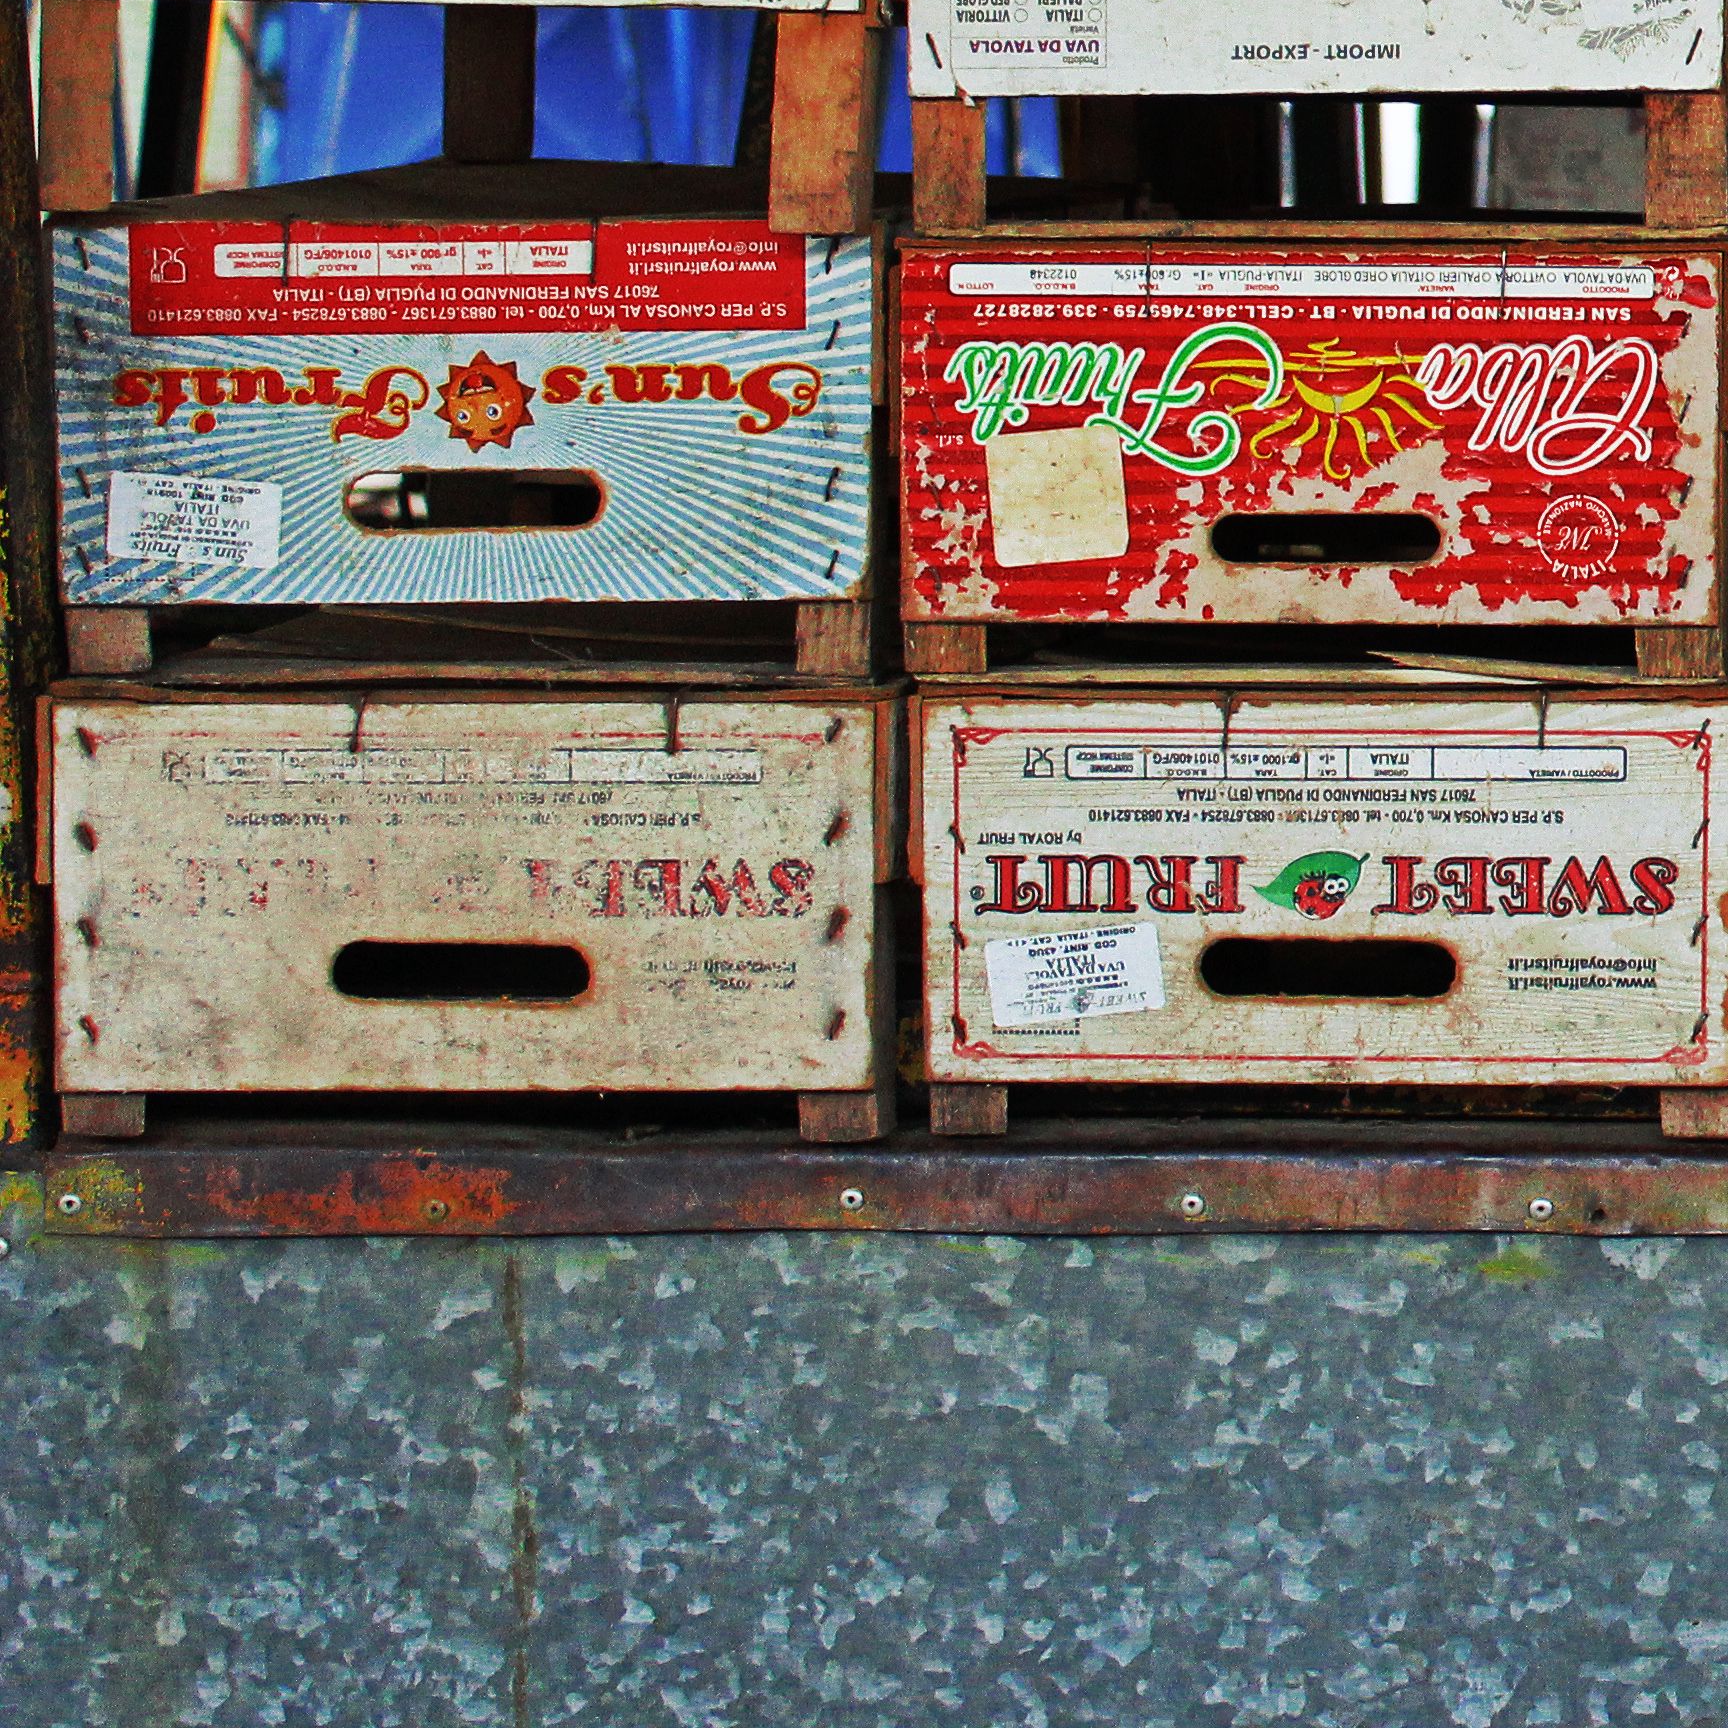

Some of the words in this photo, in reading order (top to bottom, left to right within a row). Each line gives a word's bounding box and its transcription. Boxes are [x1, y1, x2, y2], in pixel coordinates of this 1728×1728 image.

[969, 40, 1034, 52] TAVOLA
[1038, 40, 1060, 52] DA
[1065, 40, 1099, 52] UVA
[1231, 44, 1308, 60] EXPORT
[1324, 44, 1400, 60] IMPORT
[626, 240, 777, 255] info@royalfruitsrl.it
[628, 260, 776, 275] www.royalfruitsrl.it
[147, 309, 241, 321] 0883.621410
[246, 308, 277, 321] FAX
[293, 308, 387, 321] 0883.678254
[973, 303, 1097, 317] 339.2828727
[1310, 305, 1334, 318] BT
[1352, 305, 1425, 319] PUGLIA
[1431, 306, 1451, 320] DI
[1457, 306, 1585, 320] FERDINANDO
[1592, 307, 1631, 321] SAN
[110, 361, 429, 444] Fruits
[540, 359, 824, 435] Sun's
[943, 324, 1281, 476] Fruits
[1177, 788, 1216, 800] ITALIA
[1255, 788, 1304, 801] PUGLIA
[1323, 788, 1407, 801] FERDINANDO
[1411, 788, 1437, 801] SAN
[1166, 810, 1189, 821] FAX
[1454, 810, 1508, 822] CANOSA
[977, 832, 1015, 844] FRUIT
[1018, 832, 1063, 844] ROYAL
[973, 853, 1246, 916] FRUIT
[1370, 855, 1678, 918] SWEET
